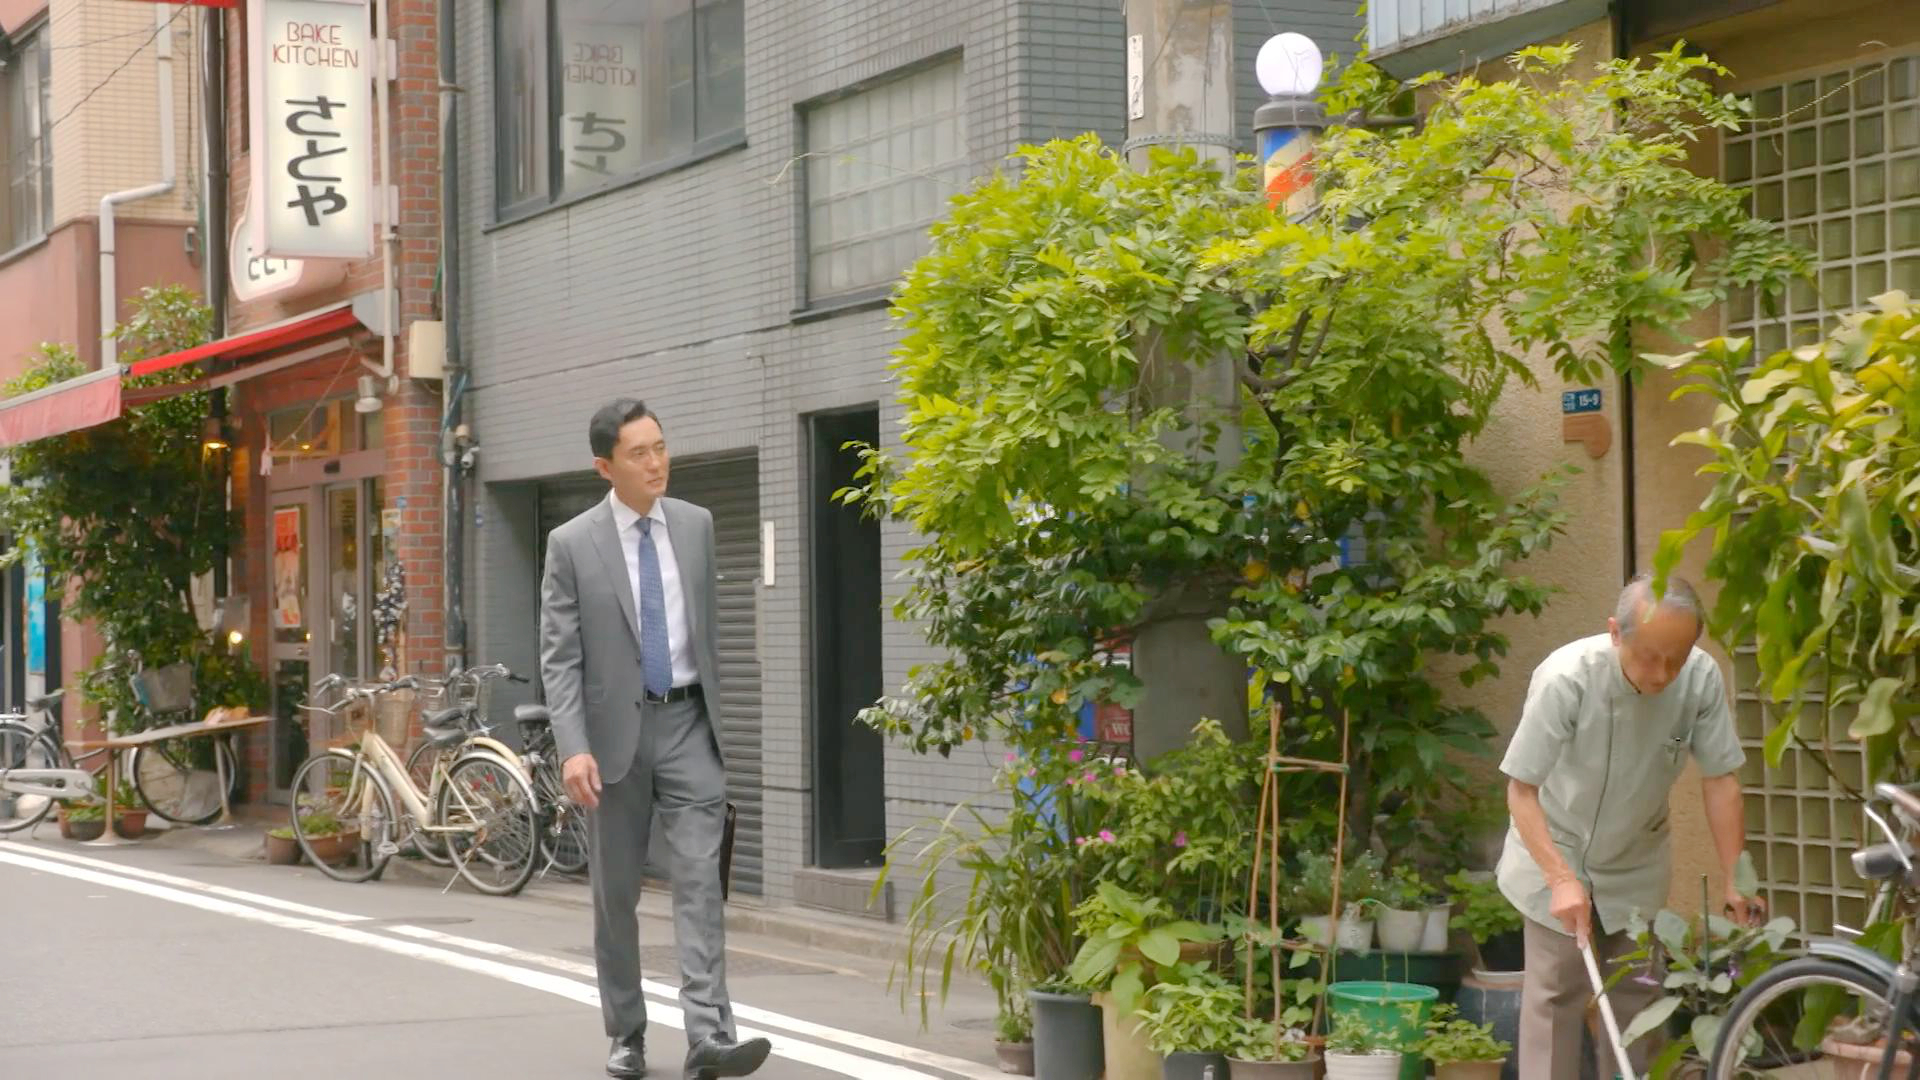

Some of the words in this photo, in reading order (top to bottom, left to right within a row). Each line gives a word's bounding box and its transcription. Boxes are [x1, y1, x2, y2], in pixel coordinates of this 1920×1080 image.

[286, 21, 343, 46] BAKE
[273, 43, 359, 68] KITCHEN
[285, 95, 348, 227] さとや
[1578, 393, 1600, 407] 15-9
